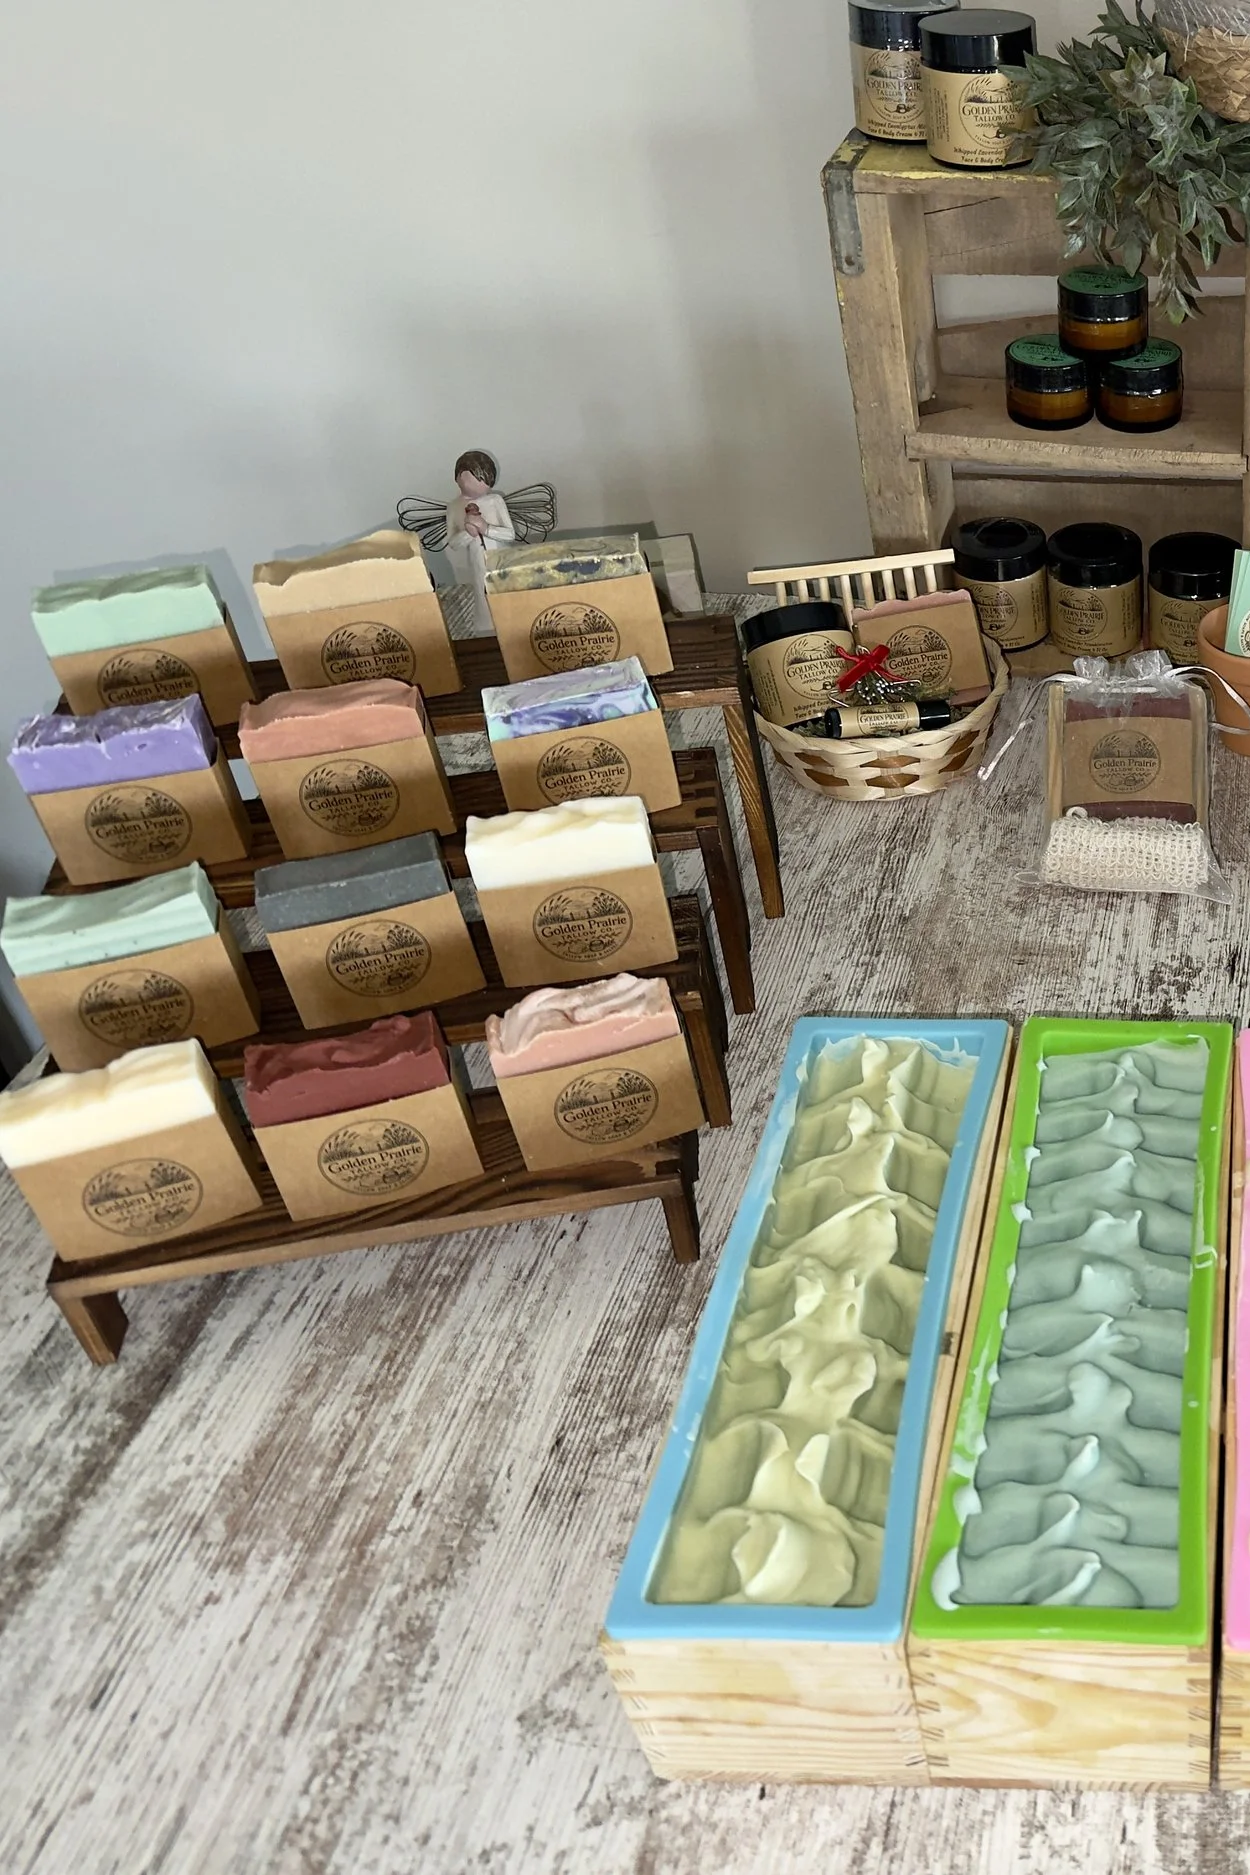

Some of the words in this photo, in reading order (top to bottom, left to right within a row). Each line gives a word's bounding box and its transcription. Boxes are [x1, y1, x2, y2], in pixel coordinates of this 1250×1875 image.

[898, 80, 923, 91] PRAIR
[962, 104, 997, 116] GOLDEN
[998, 104, 1021, 114] PRAIR
[538, 639, 577, 653] Golden
[580, 634, 615, 646] Prairie
[556, 646, 588, 655] TALLOW
[330, 660, 371, 674] Golden
[373, 654, 410, 666] Prairie
[889, 656, 919, 670] Golden
[920, 652, 948, 662] Prairie
[902, 663, 927, 671] TALLOW
[350, 666, 382, 676] TALLOW
[787, 663, 818, 678] GOLDEN
[800, 670, 827, 680] TALLOW
[108, 686, 152, 704] Golden
[154, 680, 194, 693] Prairie
[860, 714, 883, 723] GOLDEN
[1094, 759, 1126, 770] Golden
[1128, 758, 1157, 767] Prairie
[545, 775, 587, 790] Golden
[589, 766, 626, 780] Prairie
[564, 780, 597, 792] TALLOW
[308, 796, 352, 811] Golden
[354, 790, 393, 803] Prairie
[95, 822, 141, 839] Golden
[143, 817, 184, 830] Prairie
[541, 923, 585, 939] Golden
[587, 915, 627, 930] Prairie
[561, 929, 597, 940] TALLOW
[335, 957, 382, 975] Golden
[384, 947, 425, 962] Prairie
[142, 997, 186, 1014] Prairie
[563, 1104, 609, 1123] Golden
[612, 1093, 652, 1110] Prairie
[584, 1109, 621, 1123] TALLOW
[328, 1156, 376, 1175] Golden
[379, 1144, 423, 1162] Prairie
[351, 1161, 390, 1175] TALLOW
[149, 1182, 195, 1201] Prairie
